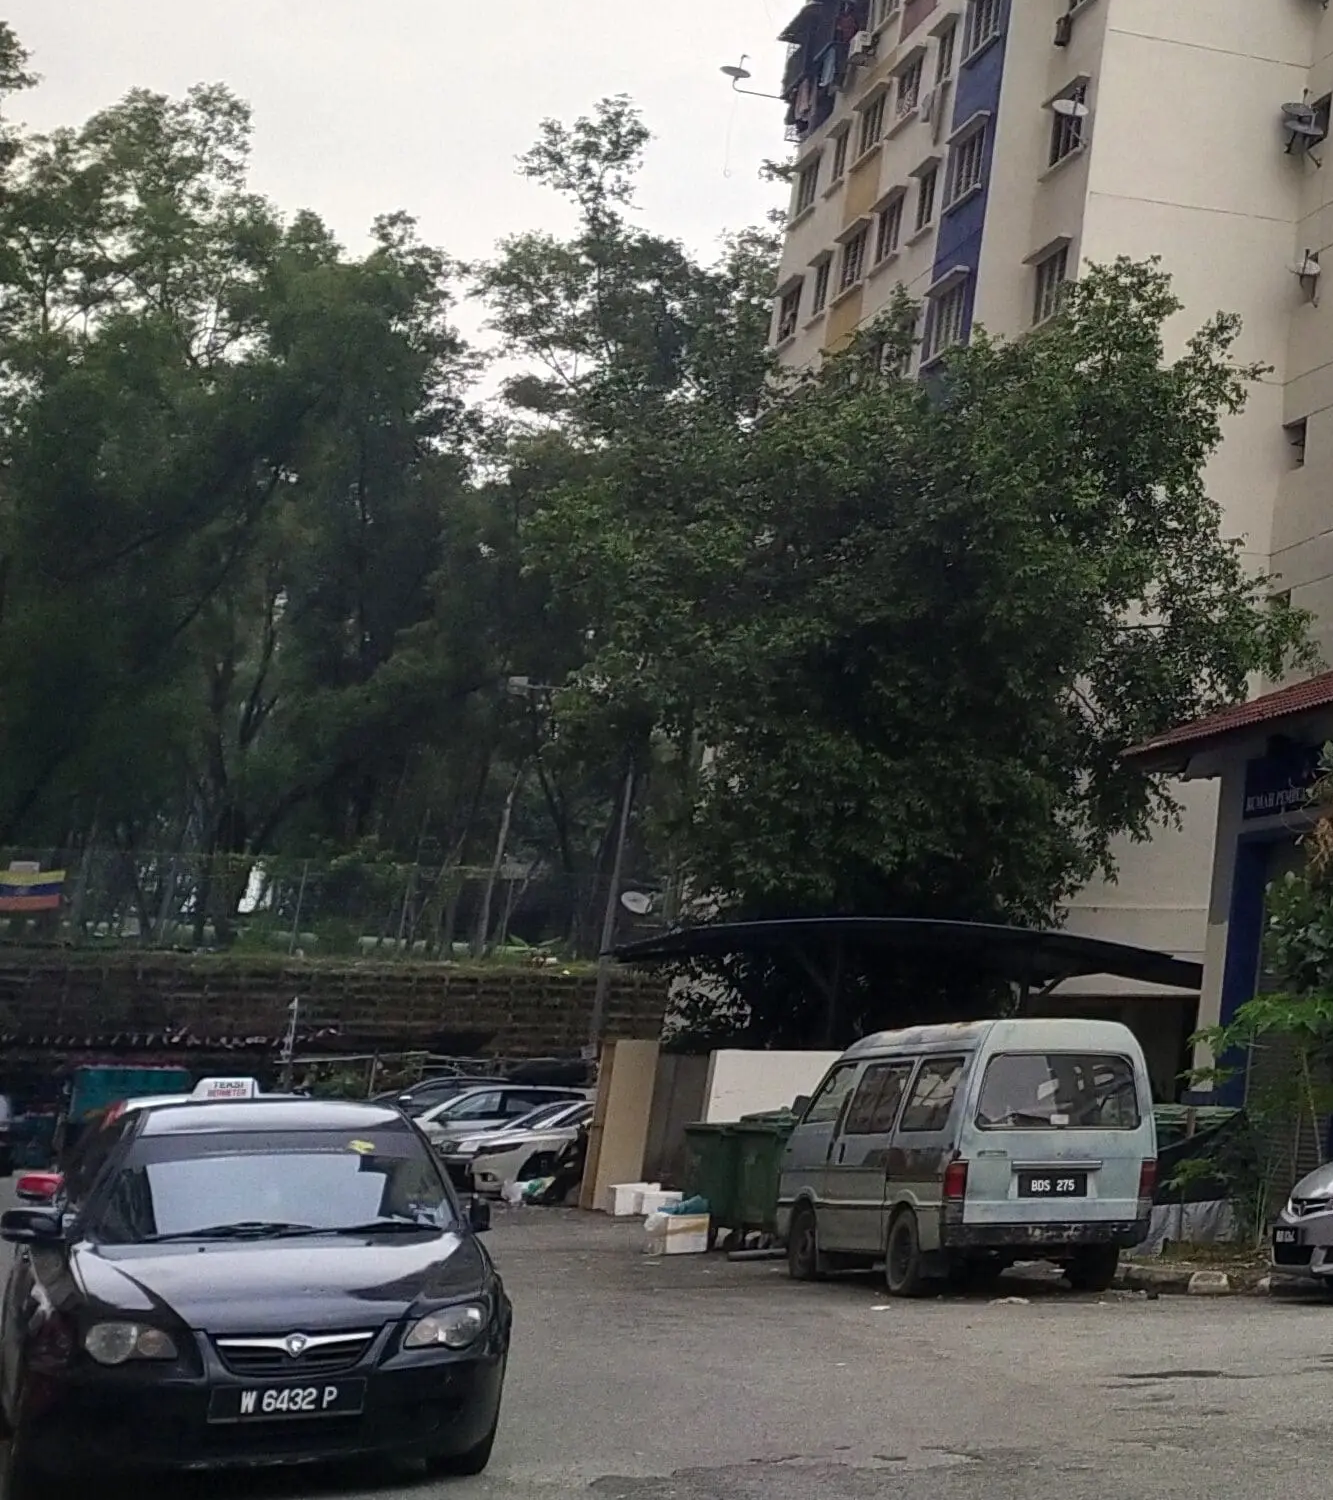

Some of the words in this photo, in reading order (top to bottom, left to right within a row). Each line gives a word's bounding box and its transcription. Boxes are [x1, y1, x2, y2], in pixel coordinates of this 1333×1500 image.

[1031, 1179, 1051, 1192] BDS
[1056, 1179, 1075, 1192] 275
[240, 1390, 258, 1414] W
[262, 1387, 318, 1412] 6432
[322, 1382, 338, 1409] P
